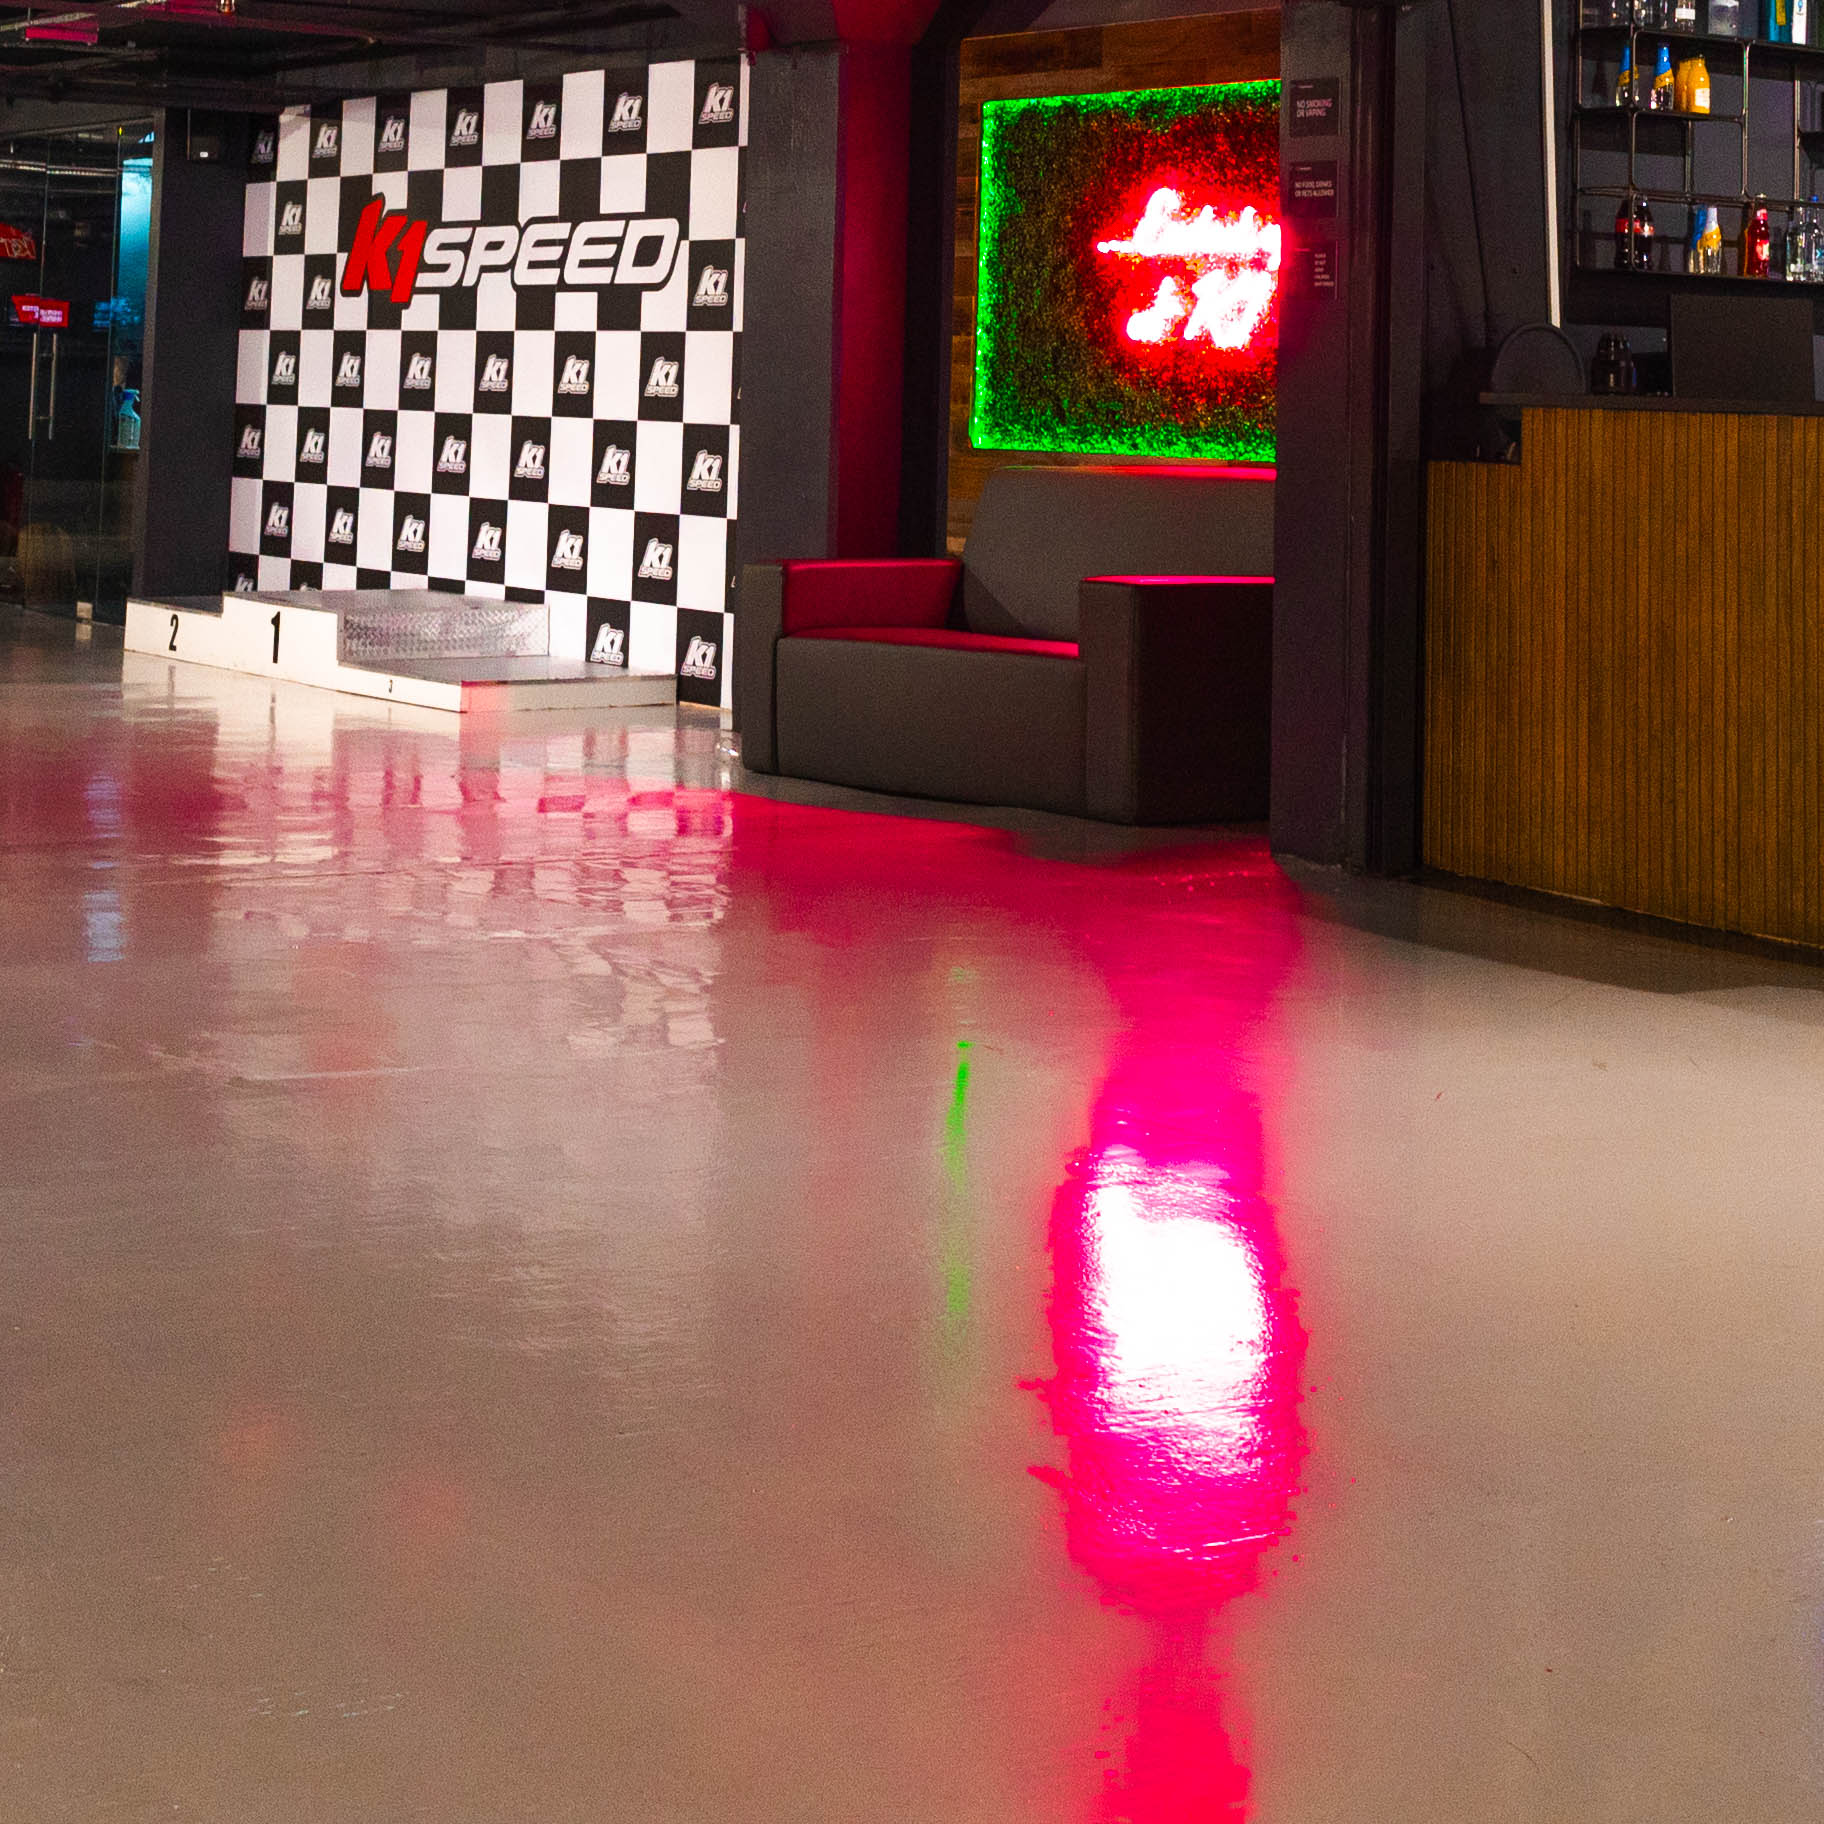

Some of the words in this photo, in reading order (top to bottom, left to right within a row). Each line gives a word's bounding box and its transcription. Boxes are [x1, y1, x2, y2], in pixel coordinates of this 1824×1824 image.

[612, 92, 642, 120] K1
[703, 83, 733, 112] K1
[1296, 99, 1305, 108] NO
[1306, 98, 1333, 108] SMOKING
[453, 110, 478, 136] K1
[530, 101, 556, 128] K1
[699, 111, 733, 124] SPEED
[1306, 108, 1326, 117] VAPING
[316, 124, 337, 148] K1
[381, 117, 404, 142] K1
[527, 127, 556, 139] SPEED
[608, 119, 642, 132] SPEED
[450, 134, 478, 146] SPEED
[282, 202, 302, 225] K1
[342, 199, 427, 303] K1
[415, 218, 679, 286] SPEED
[247, 277, 268, 300] K1
[309, 275, 331, 299] K1
[697, 265, 728, 294] K1
[693, 293, 728, 306] SPEED
[275, 351, 295, 375] K1
[339, 352, 361, 377] K1
[406, 353, 431, 379] K1
[482, 354, 508, 380] K1
[562, 355, 589, 383] K1
[648, 356, 679, 385] K1
[403, 377, 431, 389] SPEED
[479, 379, 508, 391] SPEED
[558, 382, 589, 394] SPEED
[644, 384, 679, 397] SPEED
[240, 425, 261, 449] K1
[303, 428, 324, 453] K1
[369, 432, 392, 458] K1
[440, 435, 466, 462] K1
[518, 440, 545, 468] K1
[600, 444, 630, 473] K1
[691, 449, 722, 480] K1
[437, 461, 466, 473] SPEED
[514, 467, 545, 479] SPEED
[596, 472, 630, 485] SPEED
[687, 478, 722, 492] SPEED
[268, 503, 288, 526] K1
[332, 508, 353, 534] K1
[400, 515, 425, 541] K1
[476, 522, 502, 550] K1
[397, 540, 425, 552] SPEED
[472, 549, 502, 561] SPEED
[555, 529, 583, 558] K1
[642, 538, 673, 568] K1
[551, 557, 583, 570] SPEED
[638, 567, 673, 580] SPEED
[168, 614, 178, 651] 2
[271, 611, 280, 664] 1
[594, 623, 624, 653] K1
[590, 652, 624, 665] SPEED
[684, 636, 716, 667] K1
[680, 665, 716, 679] SPEED
